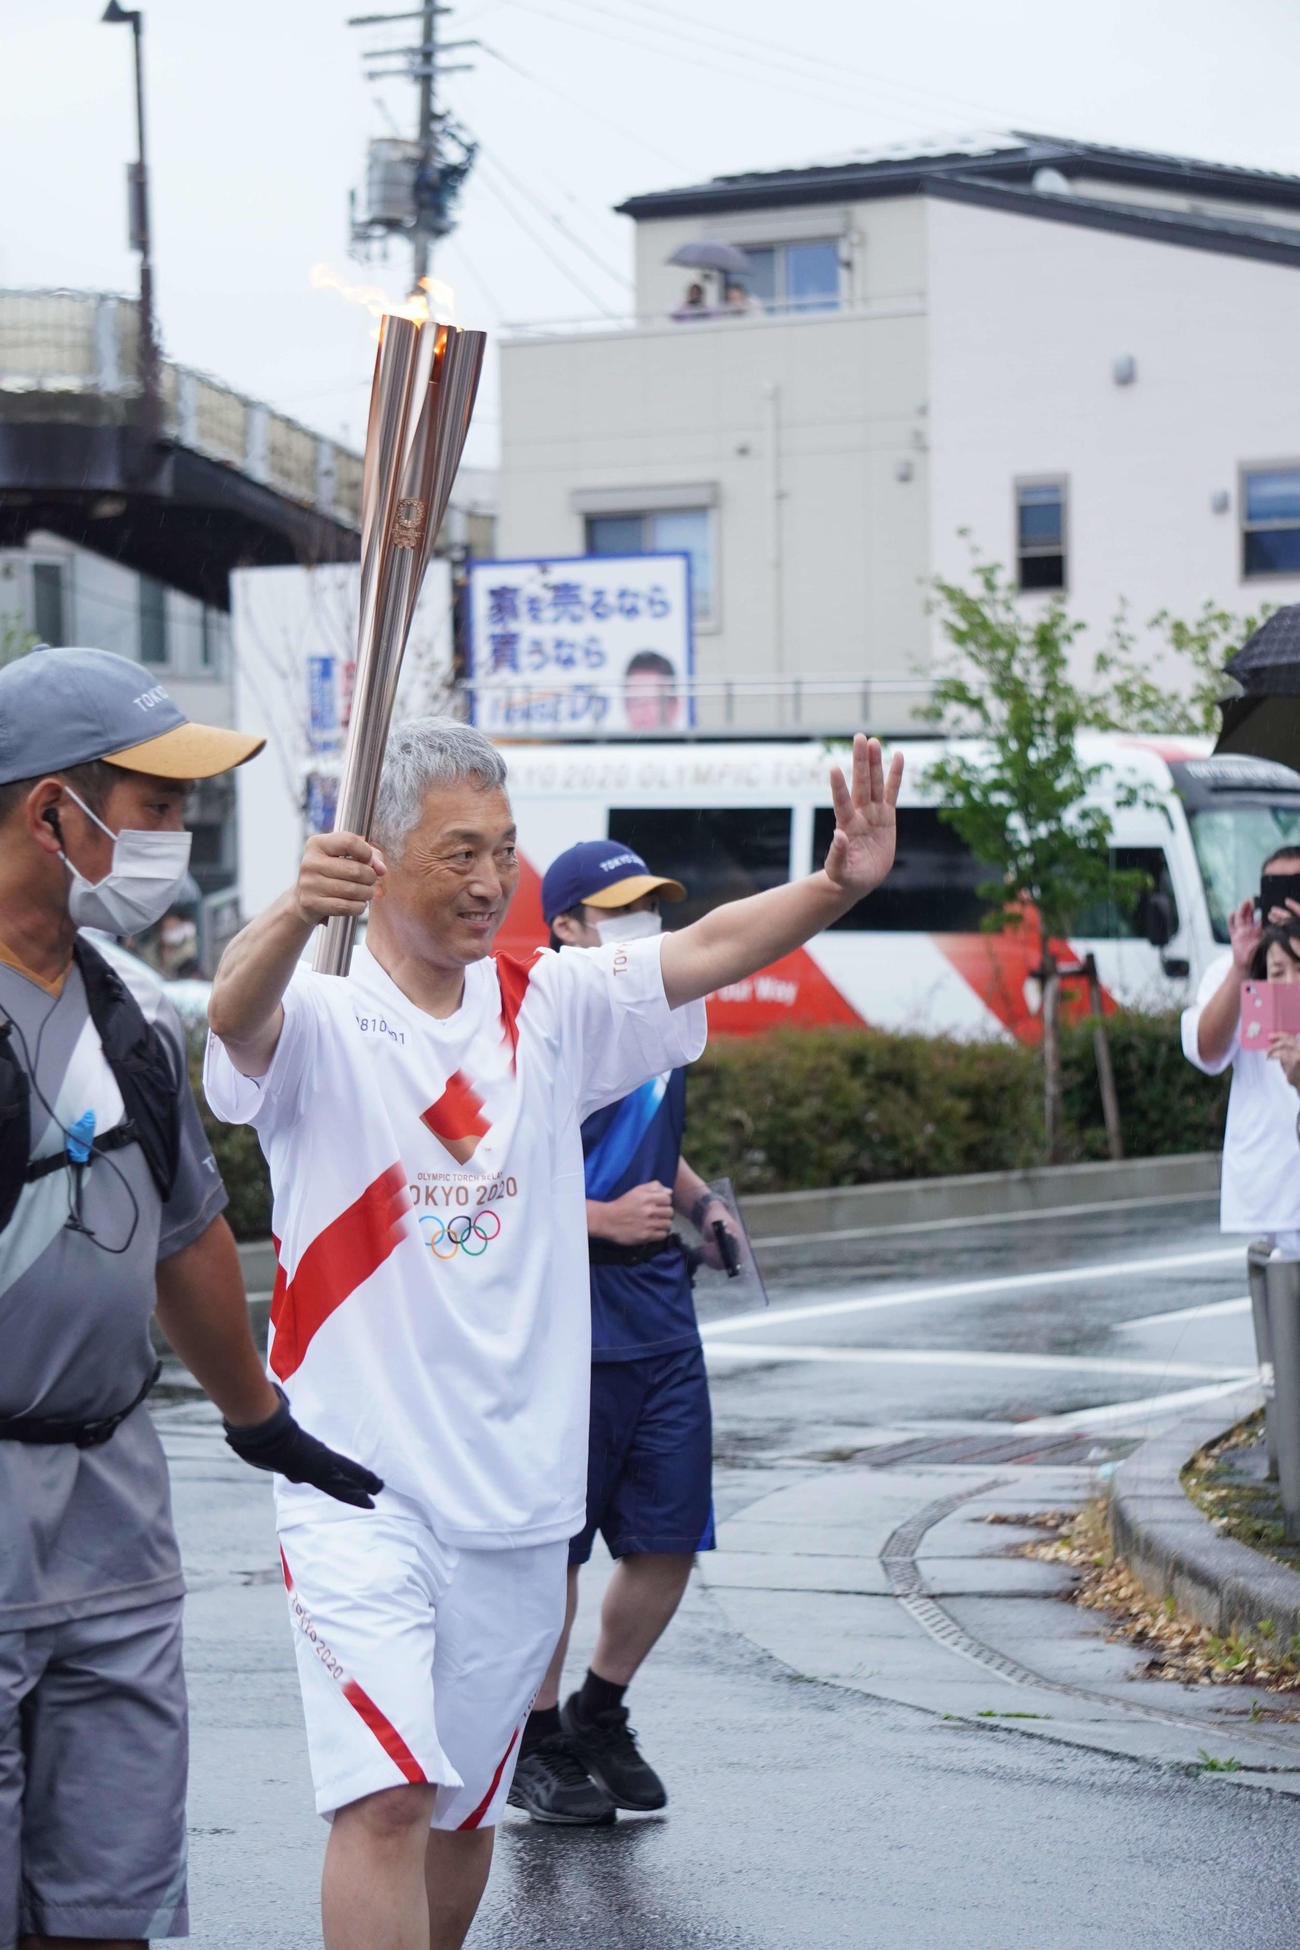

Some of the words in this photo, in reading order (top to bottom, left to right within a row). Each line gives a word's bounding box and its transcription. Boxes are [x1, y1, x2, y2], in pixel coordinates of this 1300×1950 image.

[562, 762, 629, 790] 2020
[409, 1184, 470, 1207] OKYO
[475, 1176, 518, 1206] 2020
[417, 1172, 451, 1182] OLYMPIC
[453, 1174, 479, 1182] TORCH
[316, 1640, 344, 1680] 2020
